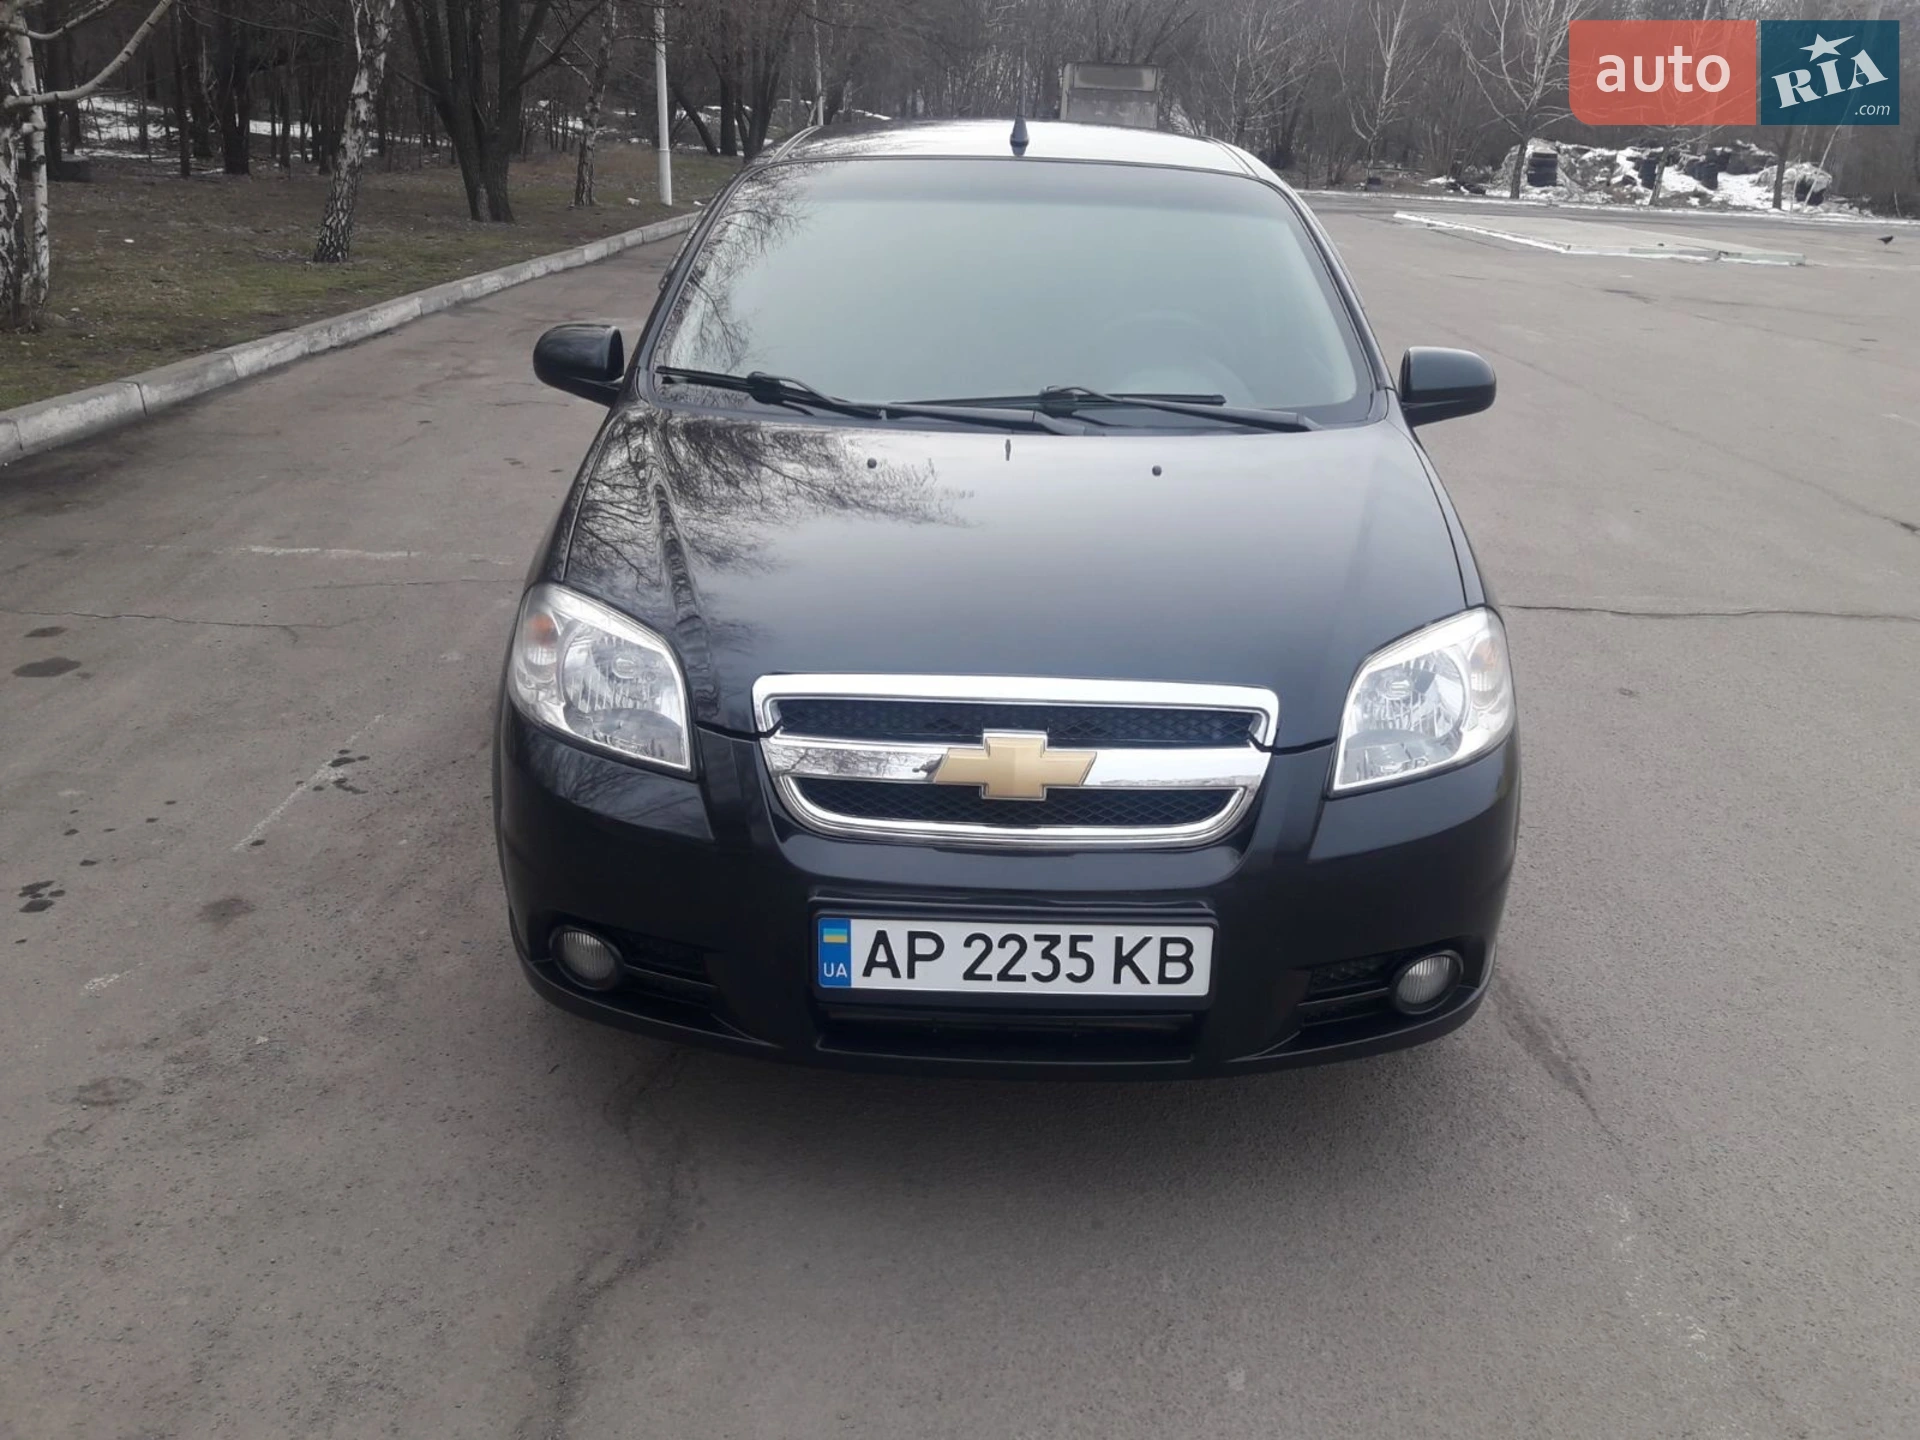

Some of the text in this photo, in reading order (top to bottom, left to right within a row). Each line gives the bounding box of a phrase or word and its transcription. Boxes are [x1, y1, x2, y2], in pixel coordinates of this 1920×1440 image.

[823, 962, 848, 978] UA
[862, 929, 1194, 985] AP 2235 KB
